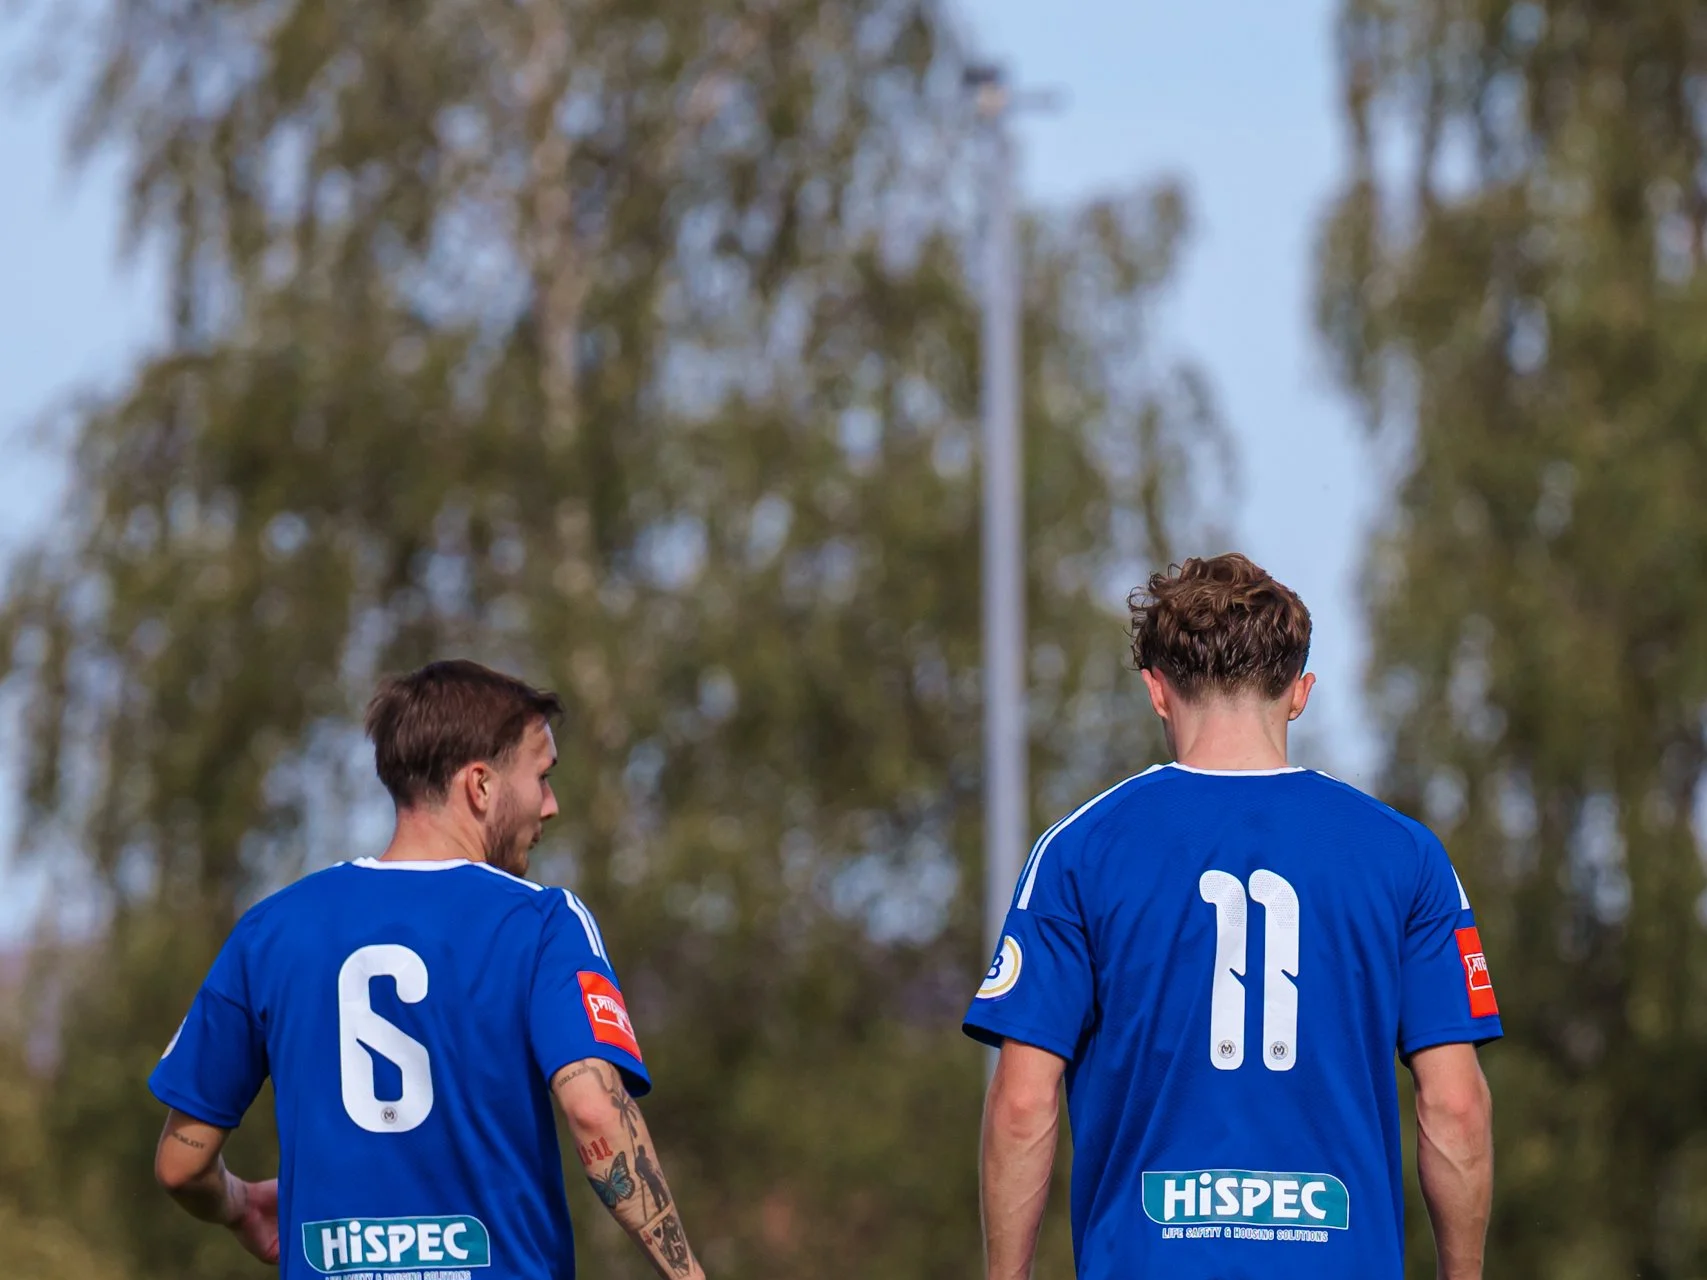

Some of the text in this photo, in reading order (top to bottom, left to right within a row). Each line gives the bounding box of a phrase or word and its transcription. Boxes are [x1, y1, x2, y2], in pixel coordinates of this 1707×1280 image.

[1199, 868, 1300, 1071] 11
[338, 943, 434, 1133] 6
[1163, 1172, 1327, 1222] HiSPEC
[321, 1220, 469, 1271] HiSPEC
[1162, 1227, 1329, 1242] LIFE SAFETY & HOUSING SOLUTIONS
